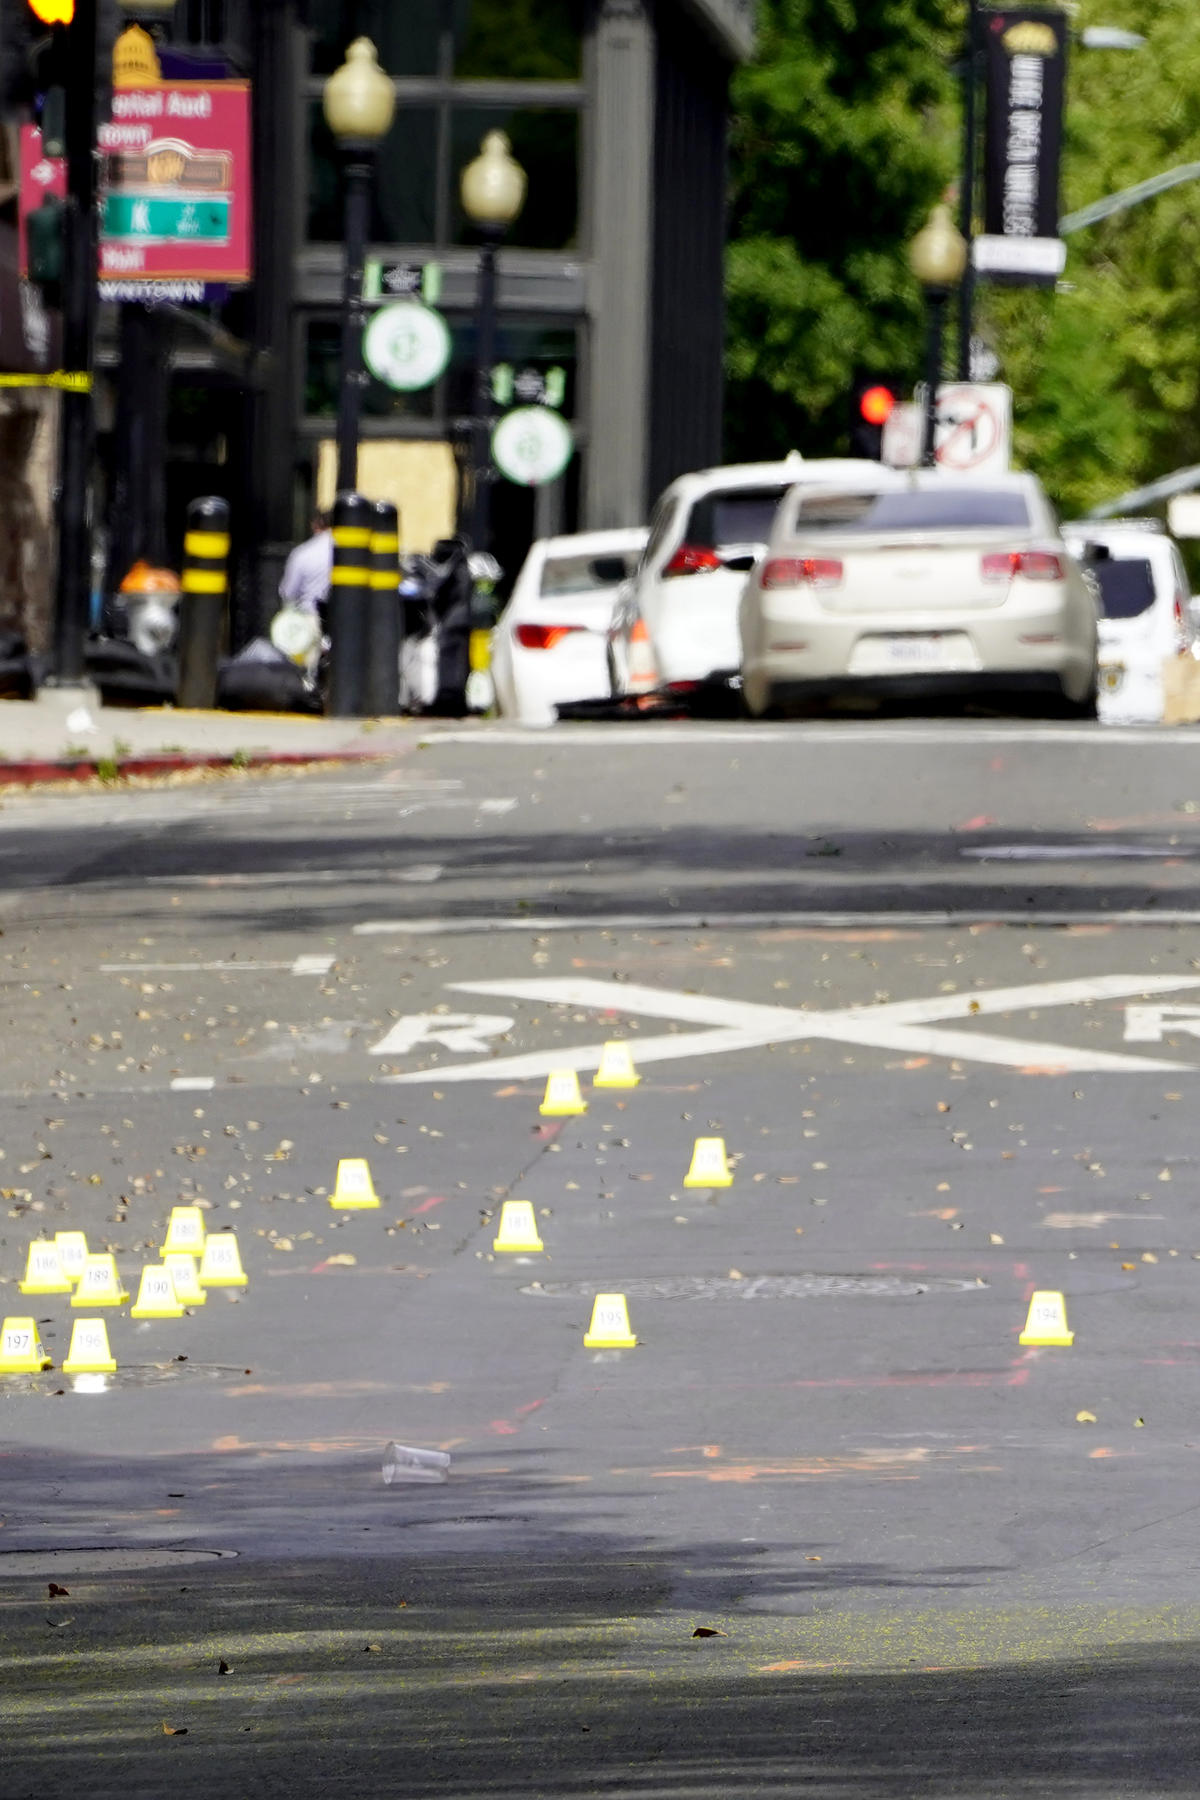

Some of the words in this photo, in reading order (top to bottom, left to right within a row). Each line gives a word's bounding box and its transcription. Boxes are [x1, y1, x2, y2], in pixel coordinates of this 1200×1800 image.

[87, 1269, 109, 1283] 189
[146, 1280, 168, 1295] 190
[1035, 1307, 1057, 1322] 194
[6, 1335, 29, 1350] 197
